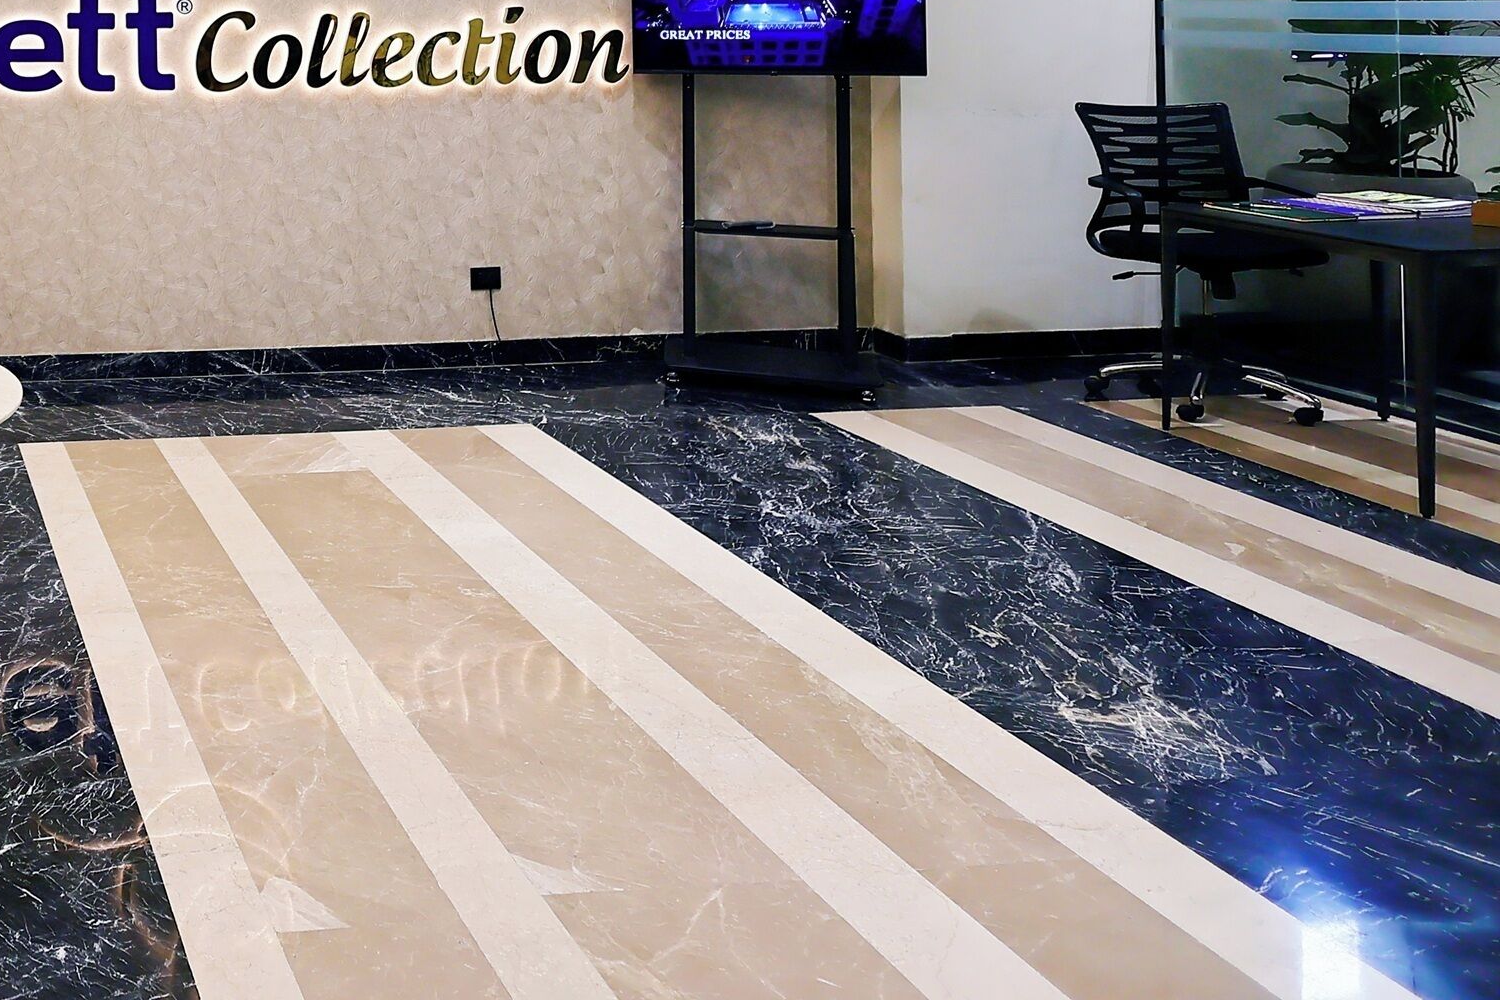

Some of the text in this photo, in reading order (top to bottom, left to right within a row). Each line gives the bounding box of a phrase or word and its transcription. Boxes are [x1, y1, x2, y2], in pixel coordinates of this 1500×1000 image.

[195, 6, 630, 92] Collection
[660, 29, 751, 40] GREAT PRICES
